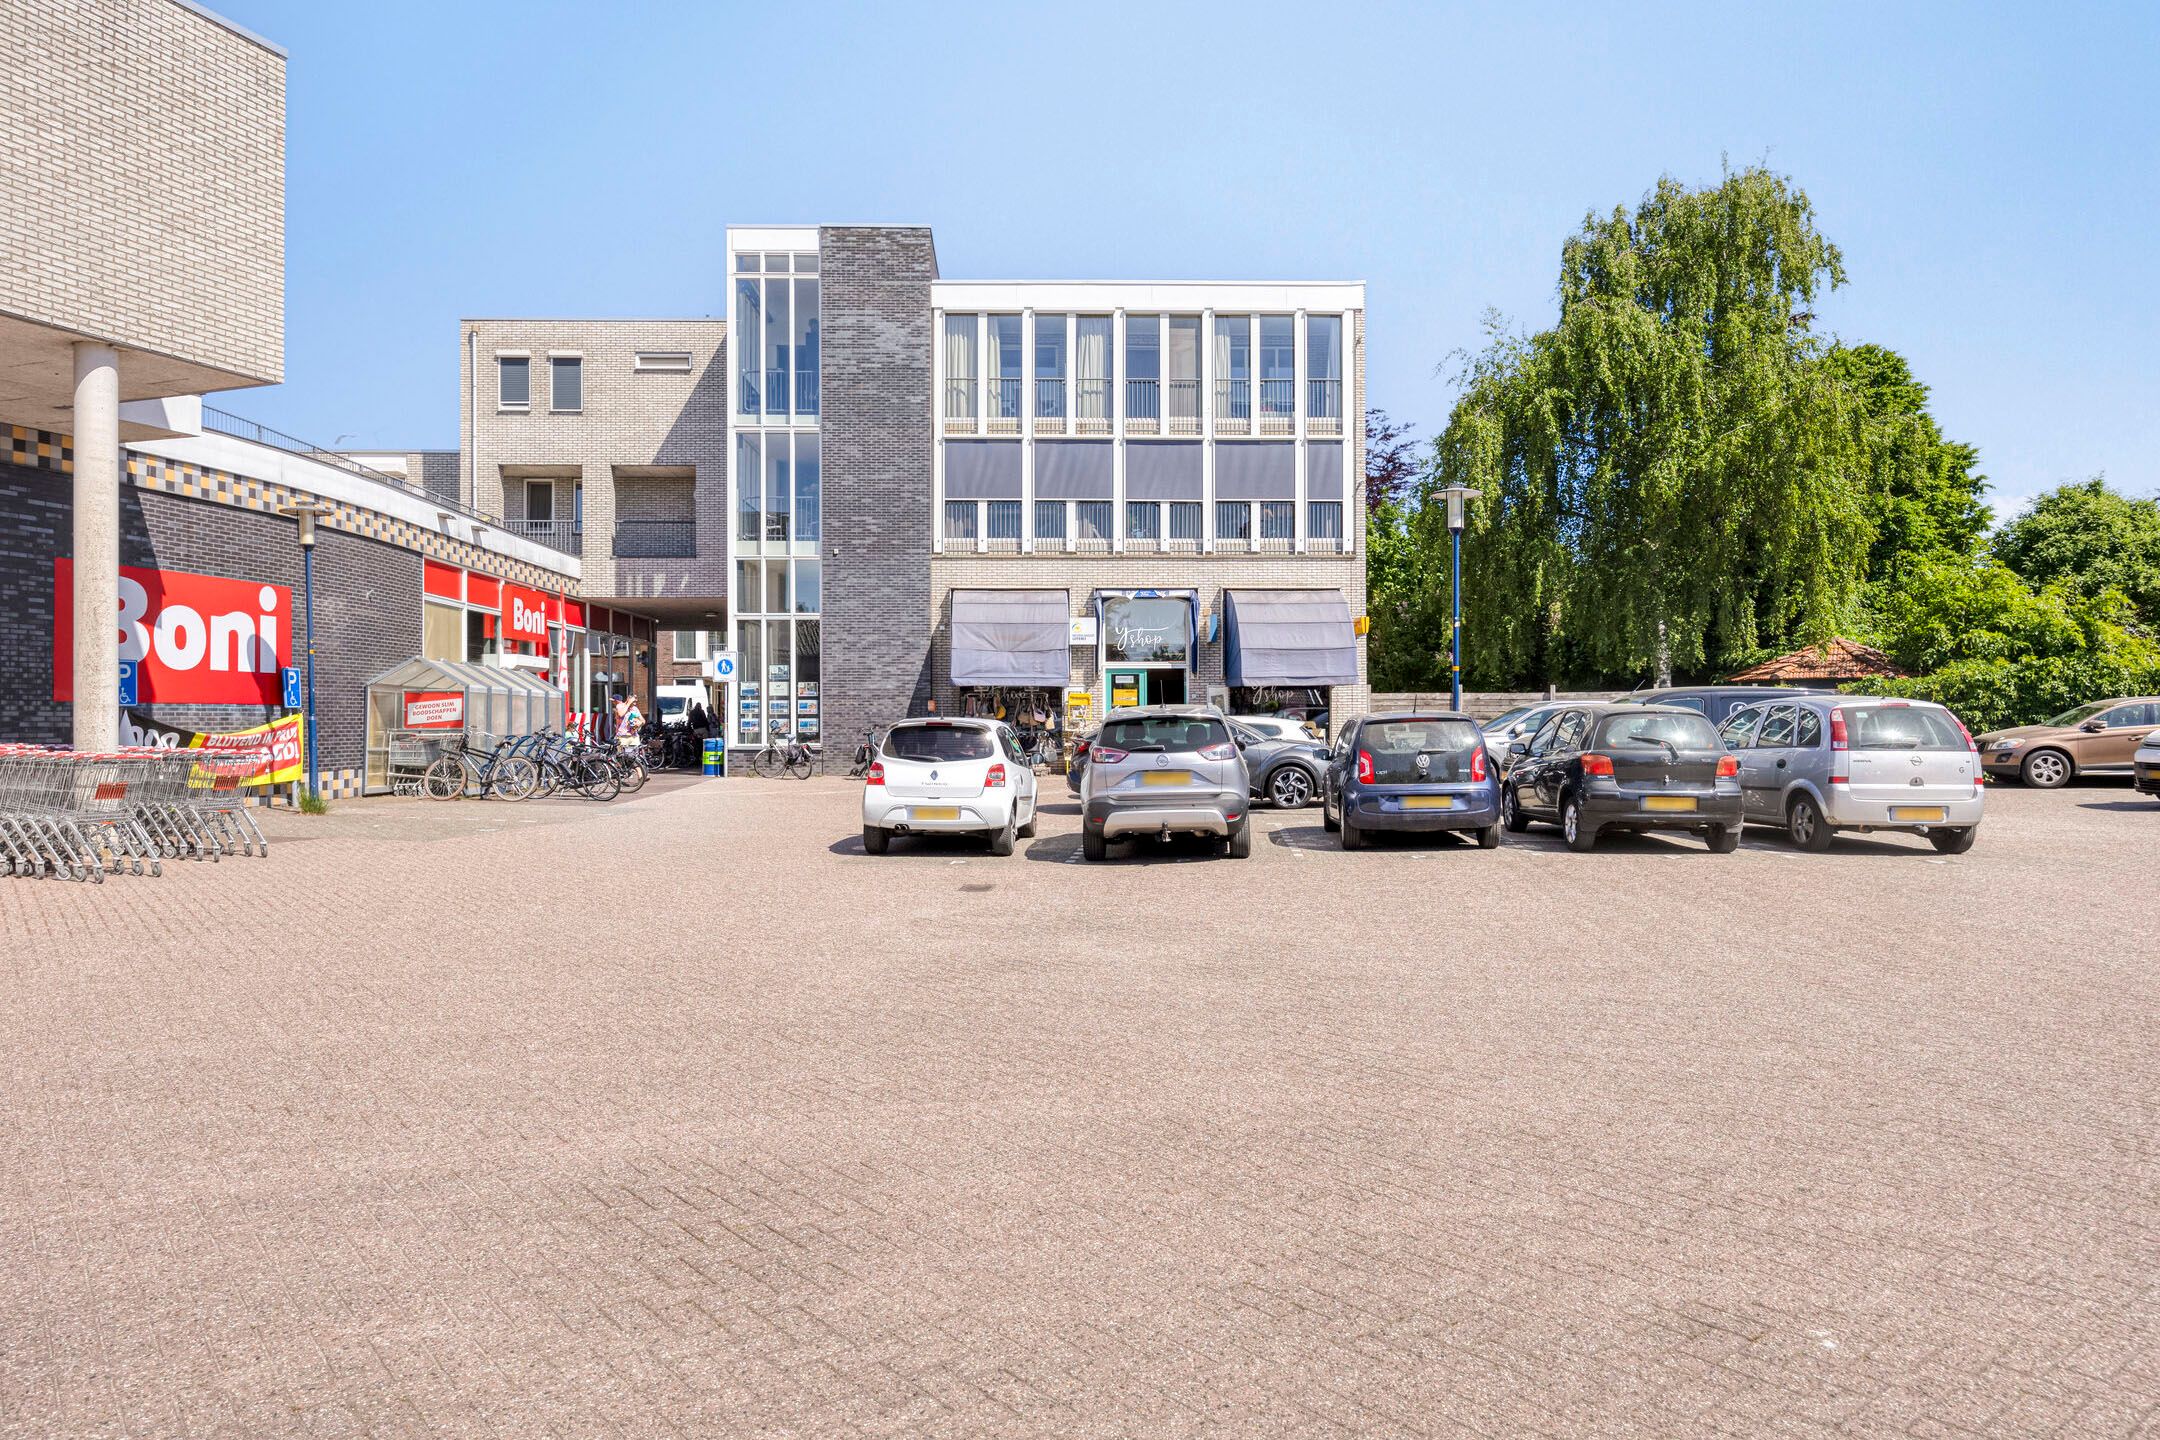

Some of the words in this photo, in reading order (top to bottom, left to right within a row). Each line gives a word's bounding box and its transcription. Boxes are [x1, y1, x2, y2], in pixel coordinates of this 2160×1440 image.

[119, 576, 277, 673] Boni
[513, 597, 545, 635] Boni
[119, 664, 131, 686] P
[288, 671, 297, 692] P
[412, 707, 457, 717] BOODSCHAPPEN
[206, 735, 261, 747] BLIJVEND
[262, 731, 274, 744] IN
